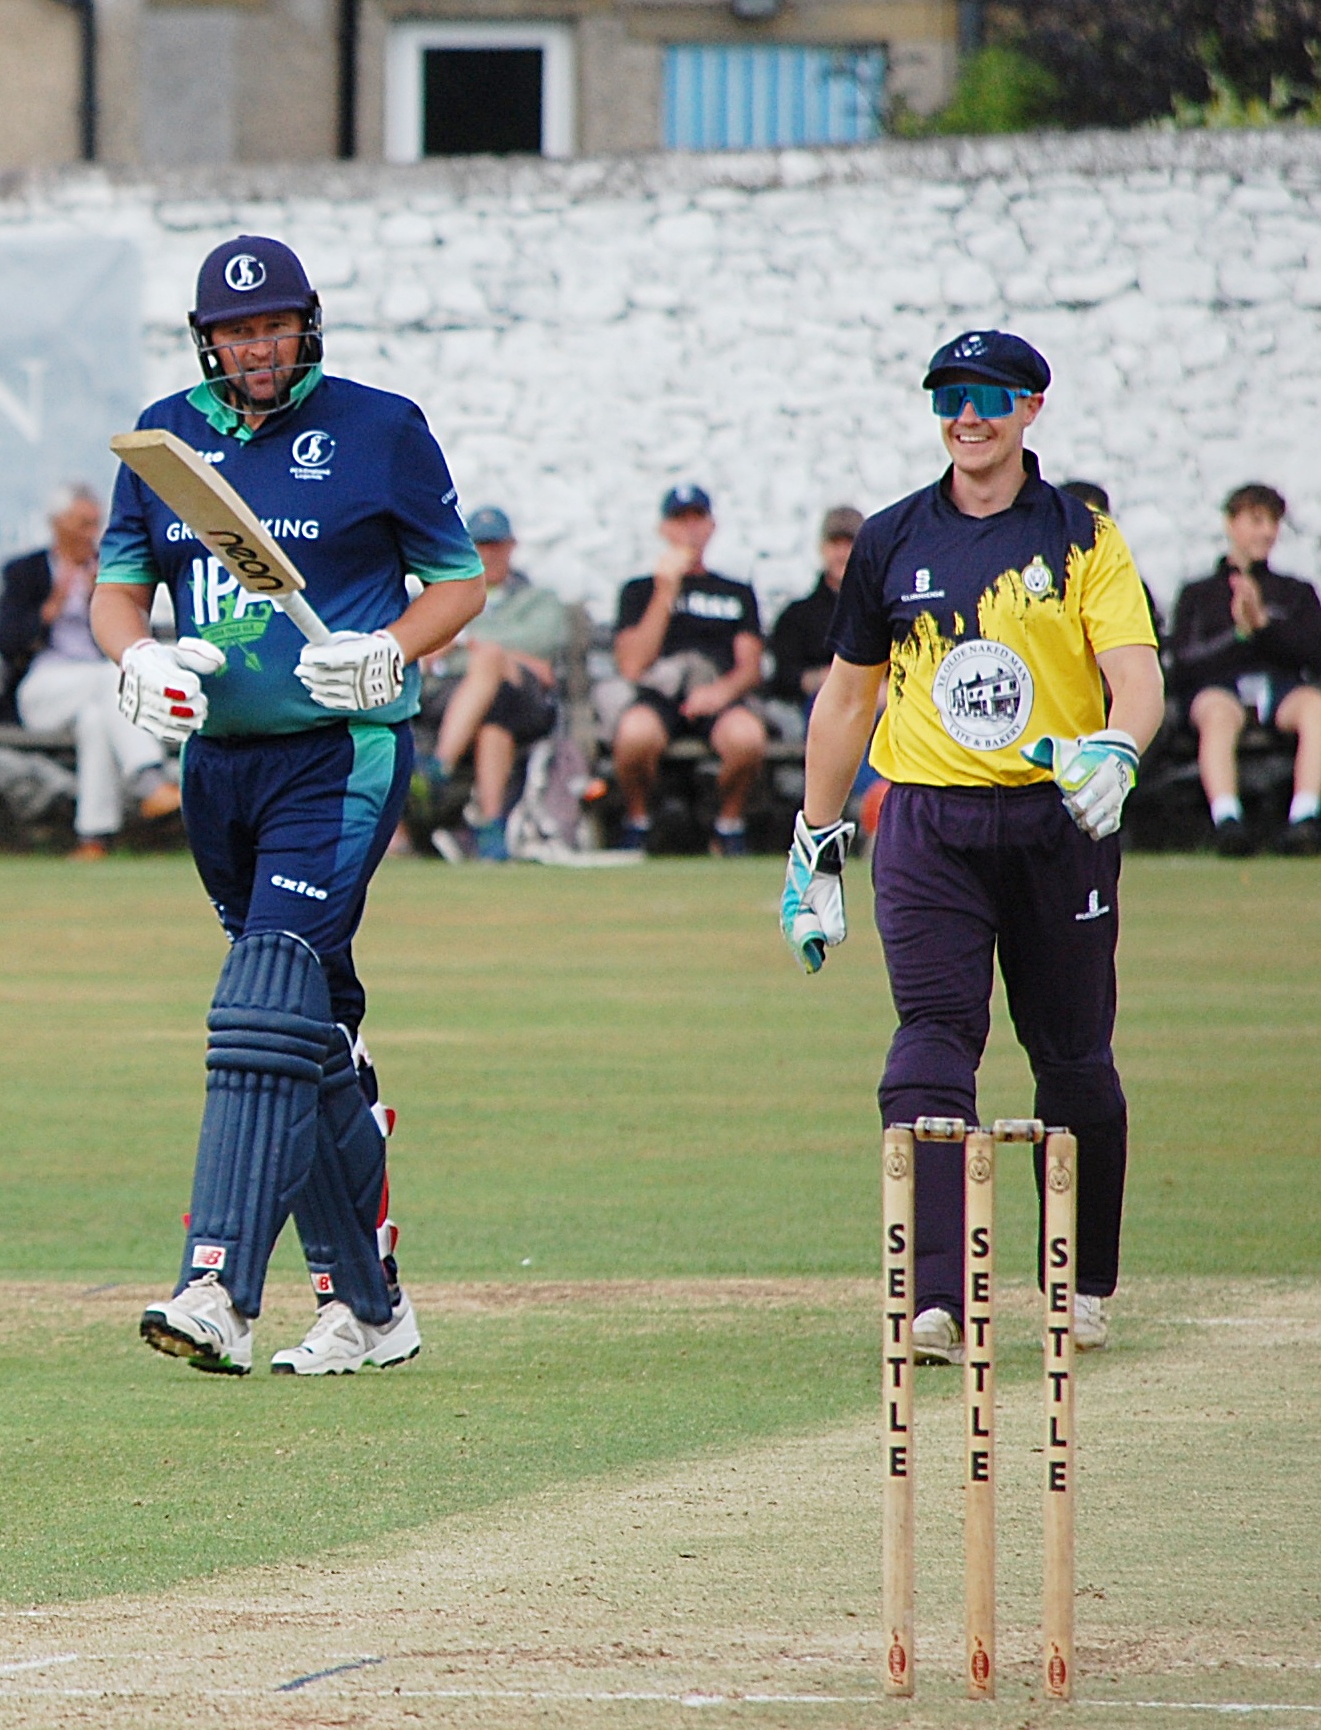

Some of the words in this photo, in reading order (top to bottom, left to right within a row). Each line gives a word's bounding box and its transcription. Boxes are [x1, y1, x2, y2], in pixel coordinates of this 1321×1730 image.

[207, 530, 284, 590] neon
[260, 519, 320, 539] KING
[192, 556, 286, 626] IPA
[969, 645, 1009, 658] NAKED
[1010, 656, 1029, 683] MAN
[985, 723, 1022, 748] BAKERY
[887, 1223, 907, 1478] SETTLE
[970, 1227, 990, 1482] SETTLE
[1048, 1237, 1068, 1492] SETTLE
